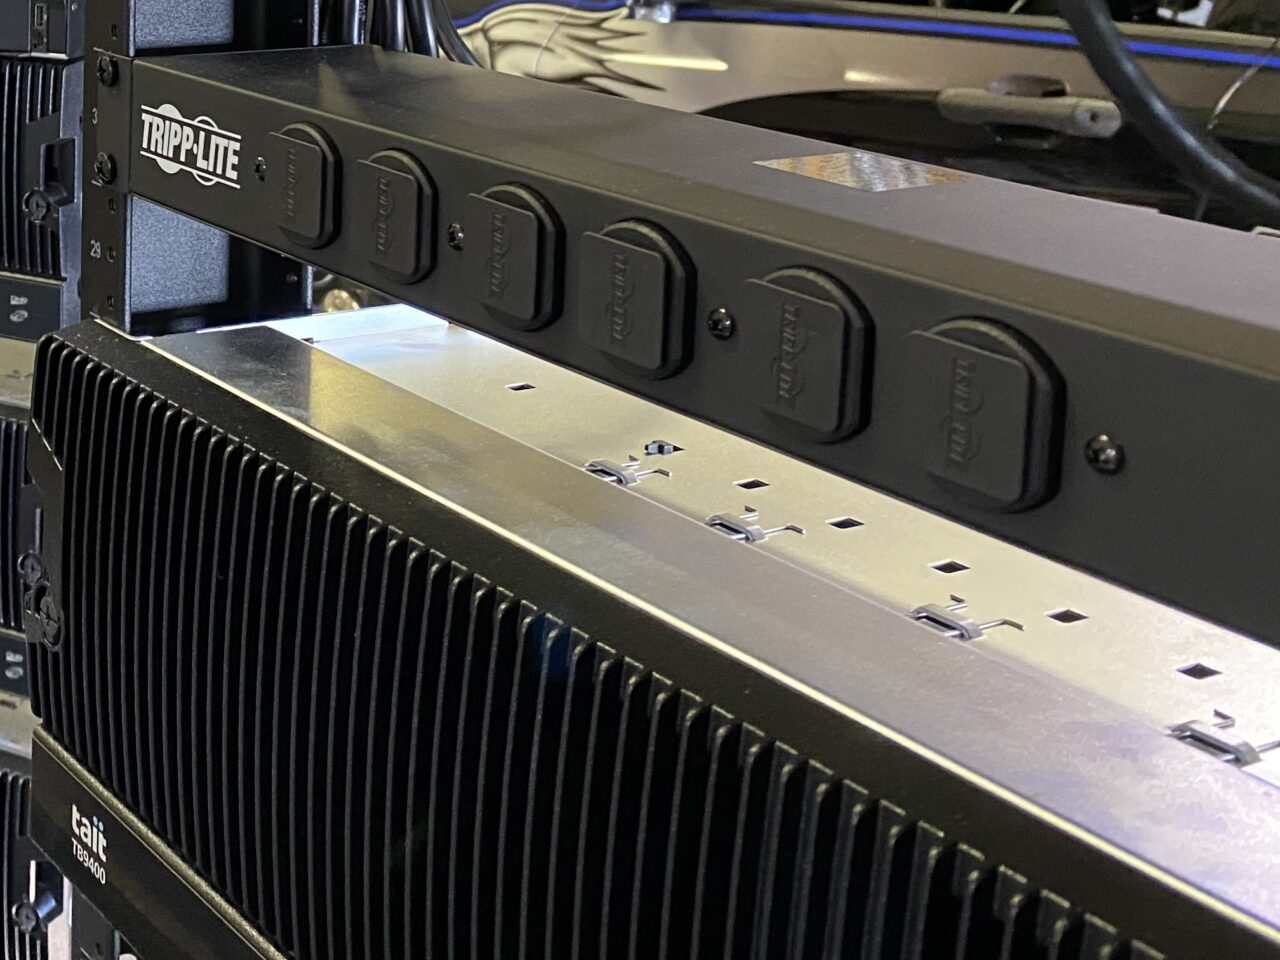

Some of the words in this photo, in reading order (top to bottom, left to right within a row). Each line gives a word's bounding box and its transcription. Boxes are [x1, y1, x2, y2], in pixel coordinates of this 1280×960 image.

[90, 239, 102, 259] 29
[72, 803, 107, 863] tait
[71, 836, 106, 885] TB9400
